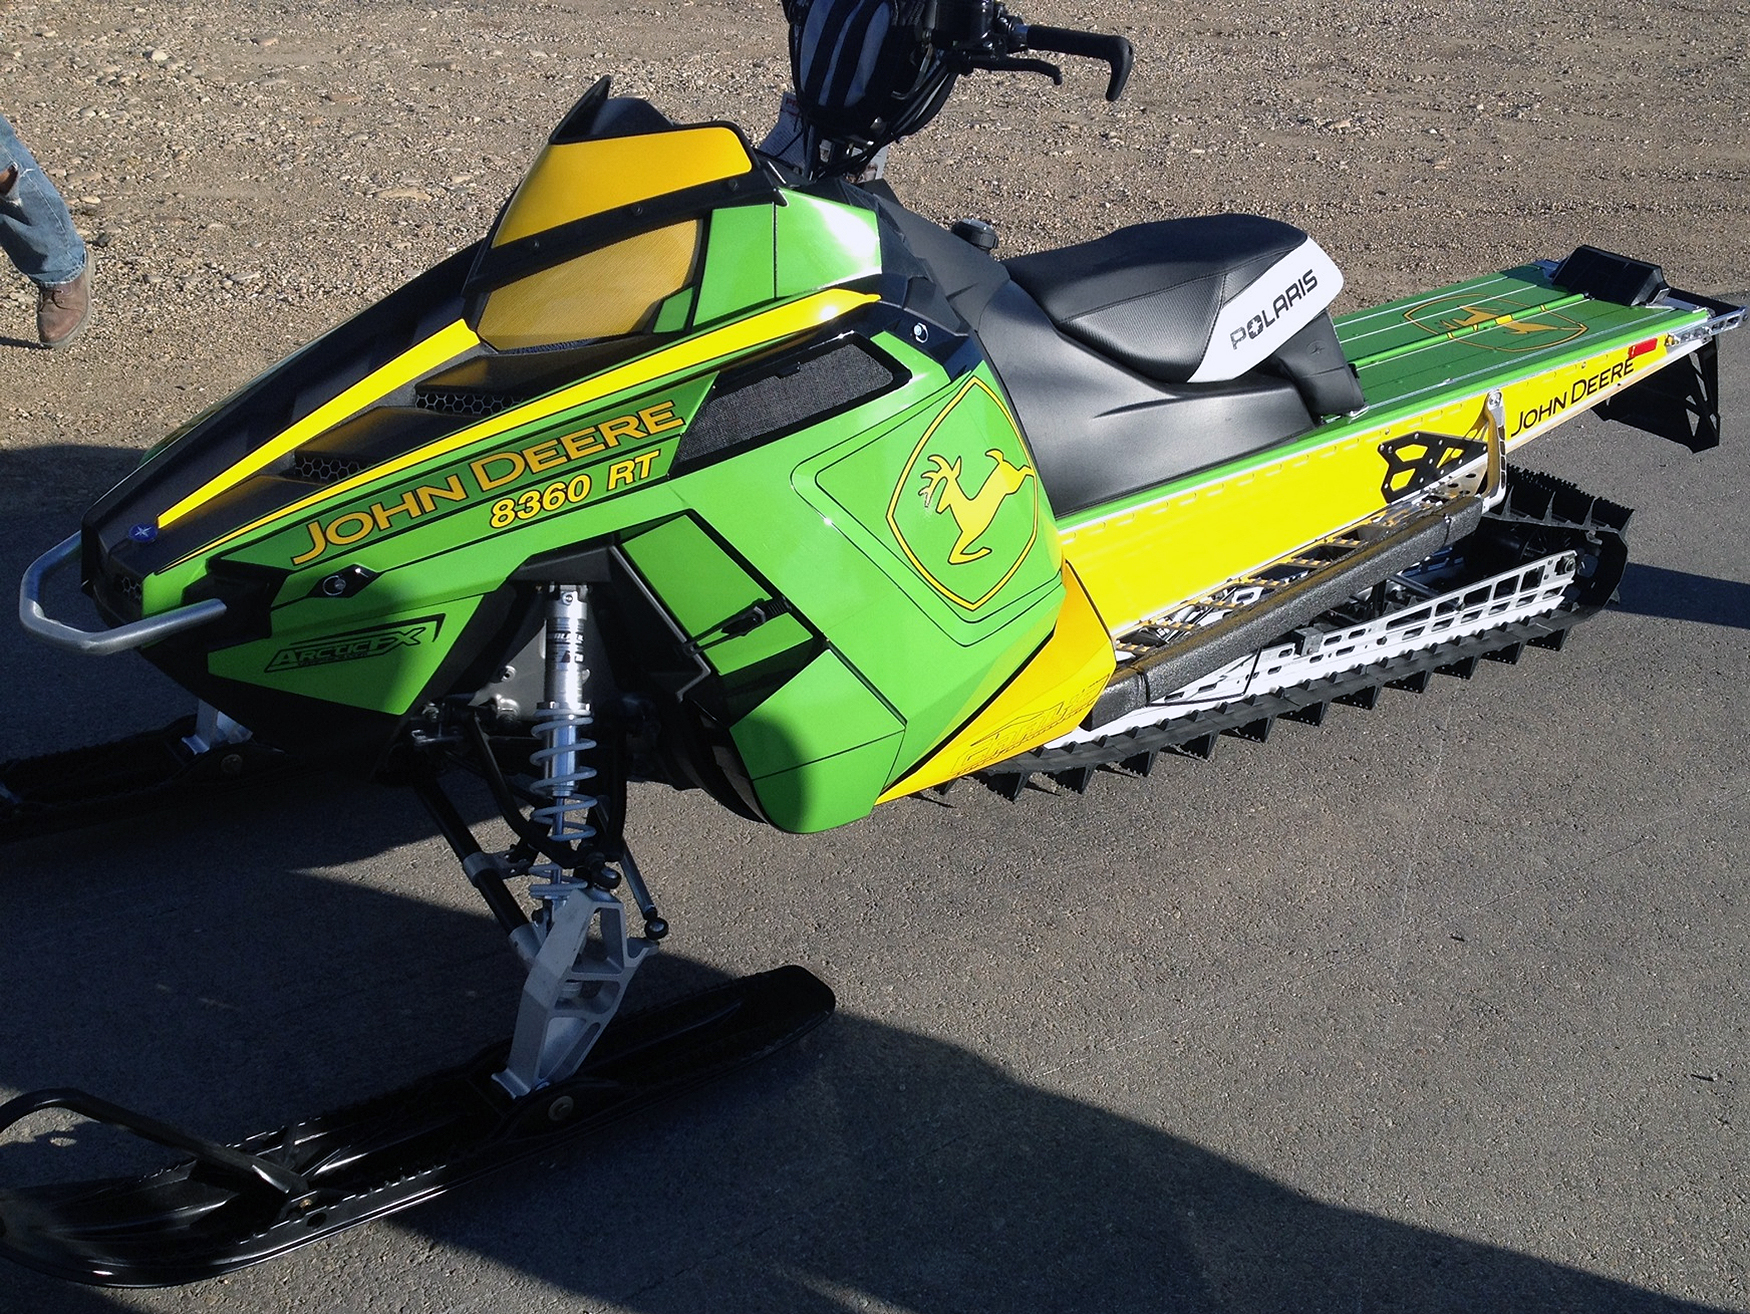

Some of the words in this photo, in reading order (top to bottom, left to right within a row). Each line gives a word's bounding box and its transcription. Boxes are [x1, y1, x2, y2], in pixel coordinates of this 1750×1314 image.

[1229, 268, 1318, 351] POLARIS
[1510, 391, 1568, 438] JOHN
[1570, 358, 1635, 405] DEERE
[291, 473, 468, 566] JOHN
[469, 401, 686, 493] DEERE
[490, 473, 592, 529] 8360
[606, 449, 662, 490] RT
